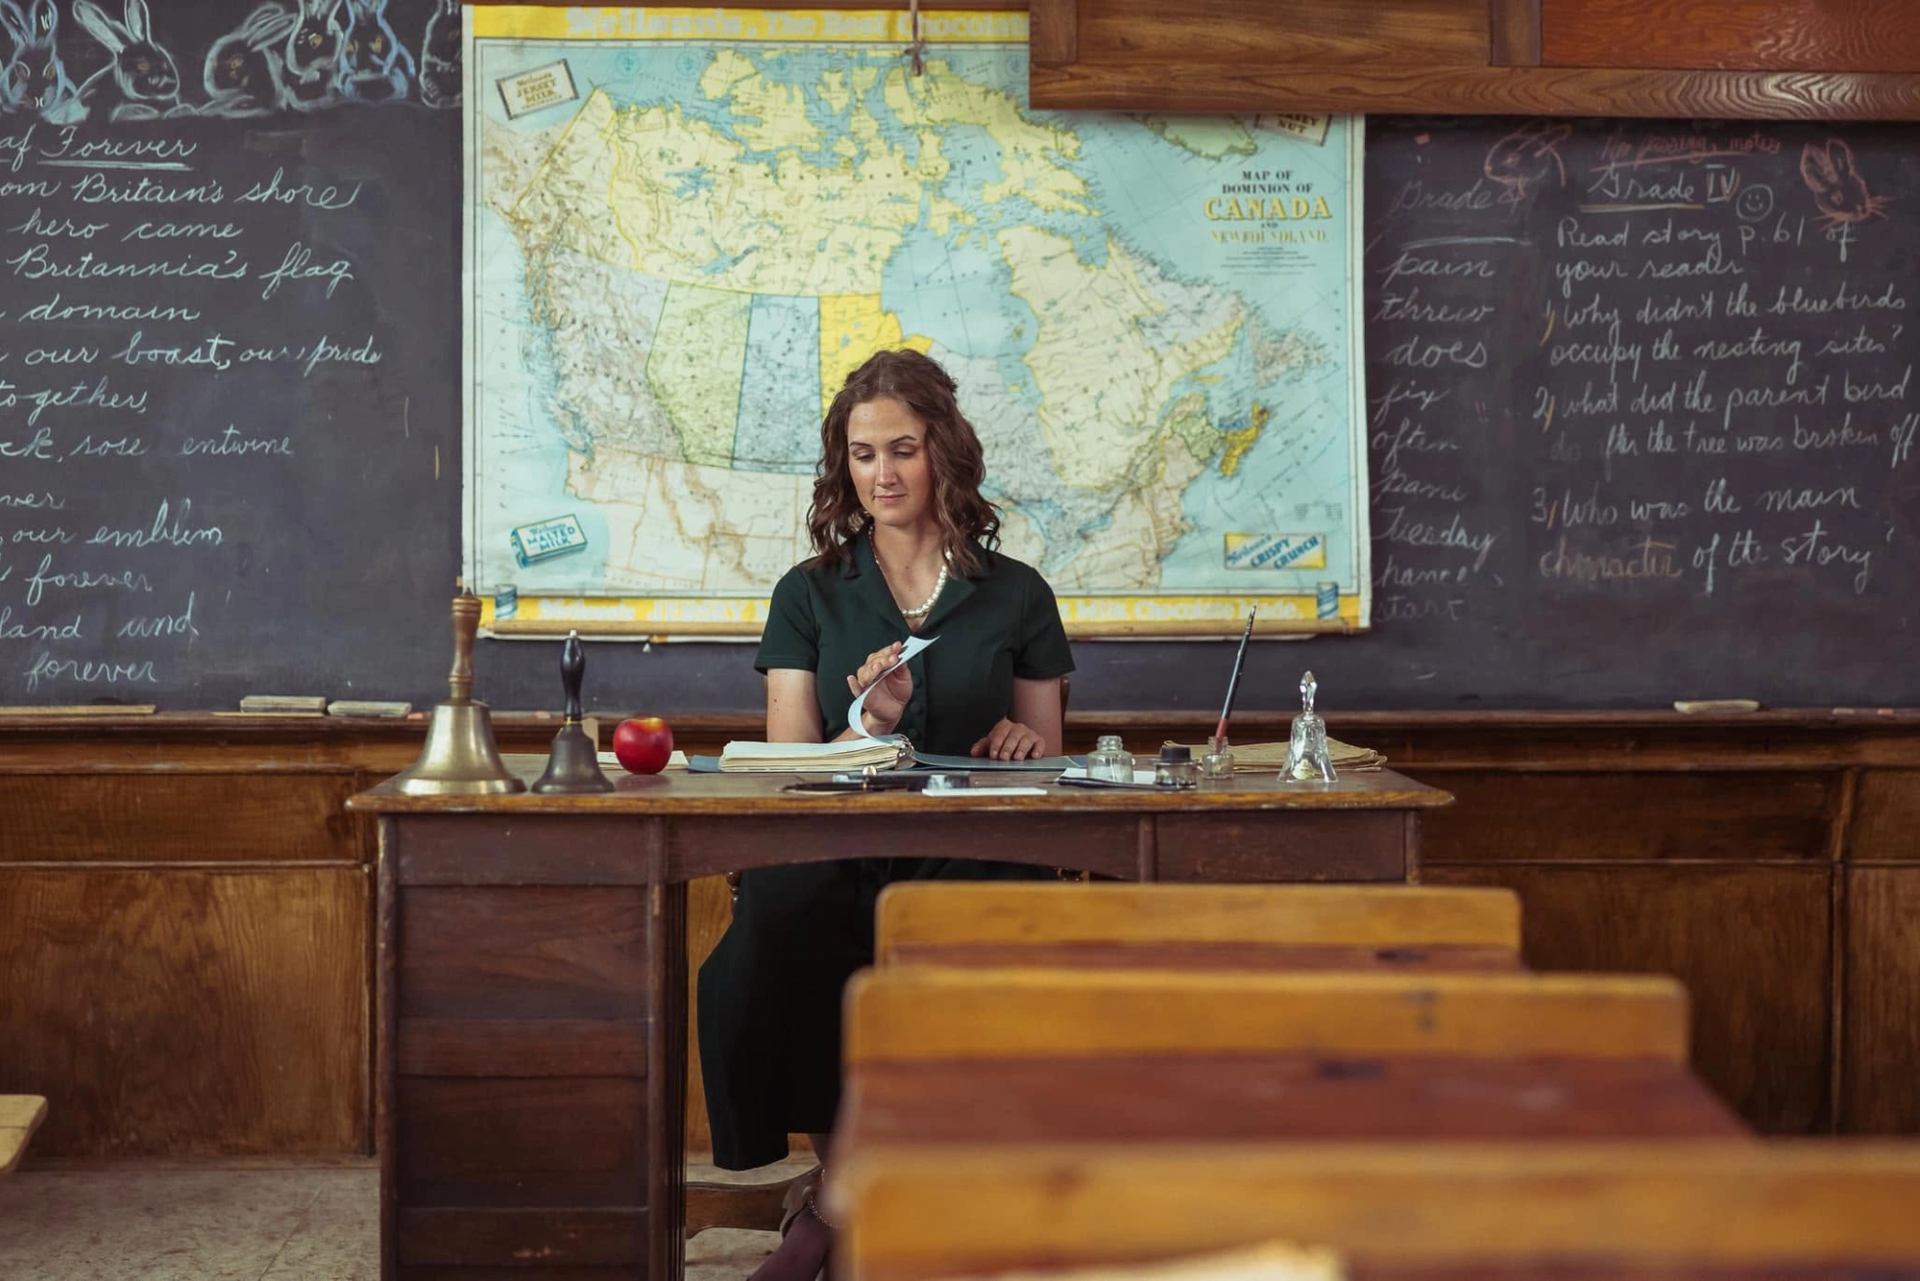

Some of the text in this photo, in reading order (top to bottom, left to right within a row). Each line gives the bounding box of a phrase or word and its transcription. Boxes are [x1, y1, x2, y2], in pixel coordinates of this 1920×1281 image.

[1222, 183, 1313, 195] DOMINION OF
[1242, 170, 1292, 181] MAP OF
[1203, 195, 1333, 221] CANADA
[7, 208, 244, 242] hero came
[1557, 216, 1630, 248] Read
[259, 242, 354, 300] flag
[1725, 281, 1758, 318] the
[25, 346, 99, 366] our
[1651, 328, 1682, 361] the
[1629, 382, 1678, 415] did
[1683, 368, 1717, 413] the
[1646, 418, 1678, 454] the
[1702, 476, 1742, 514] the
